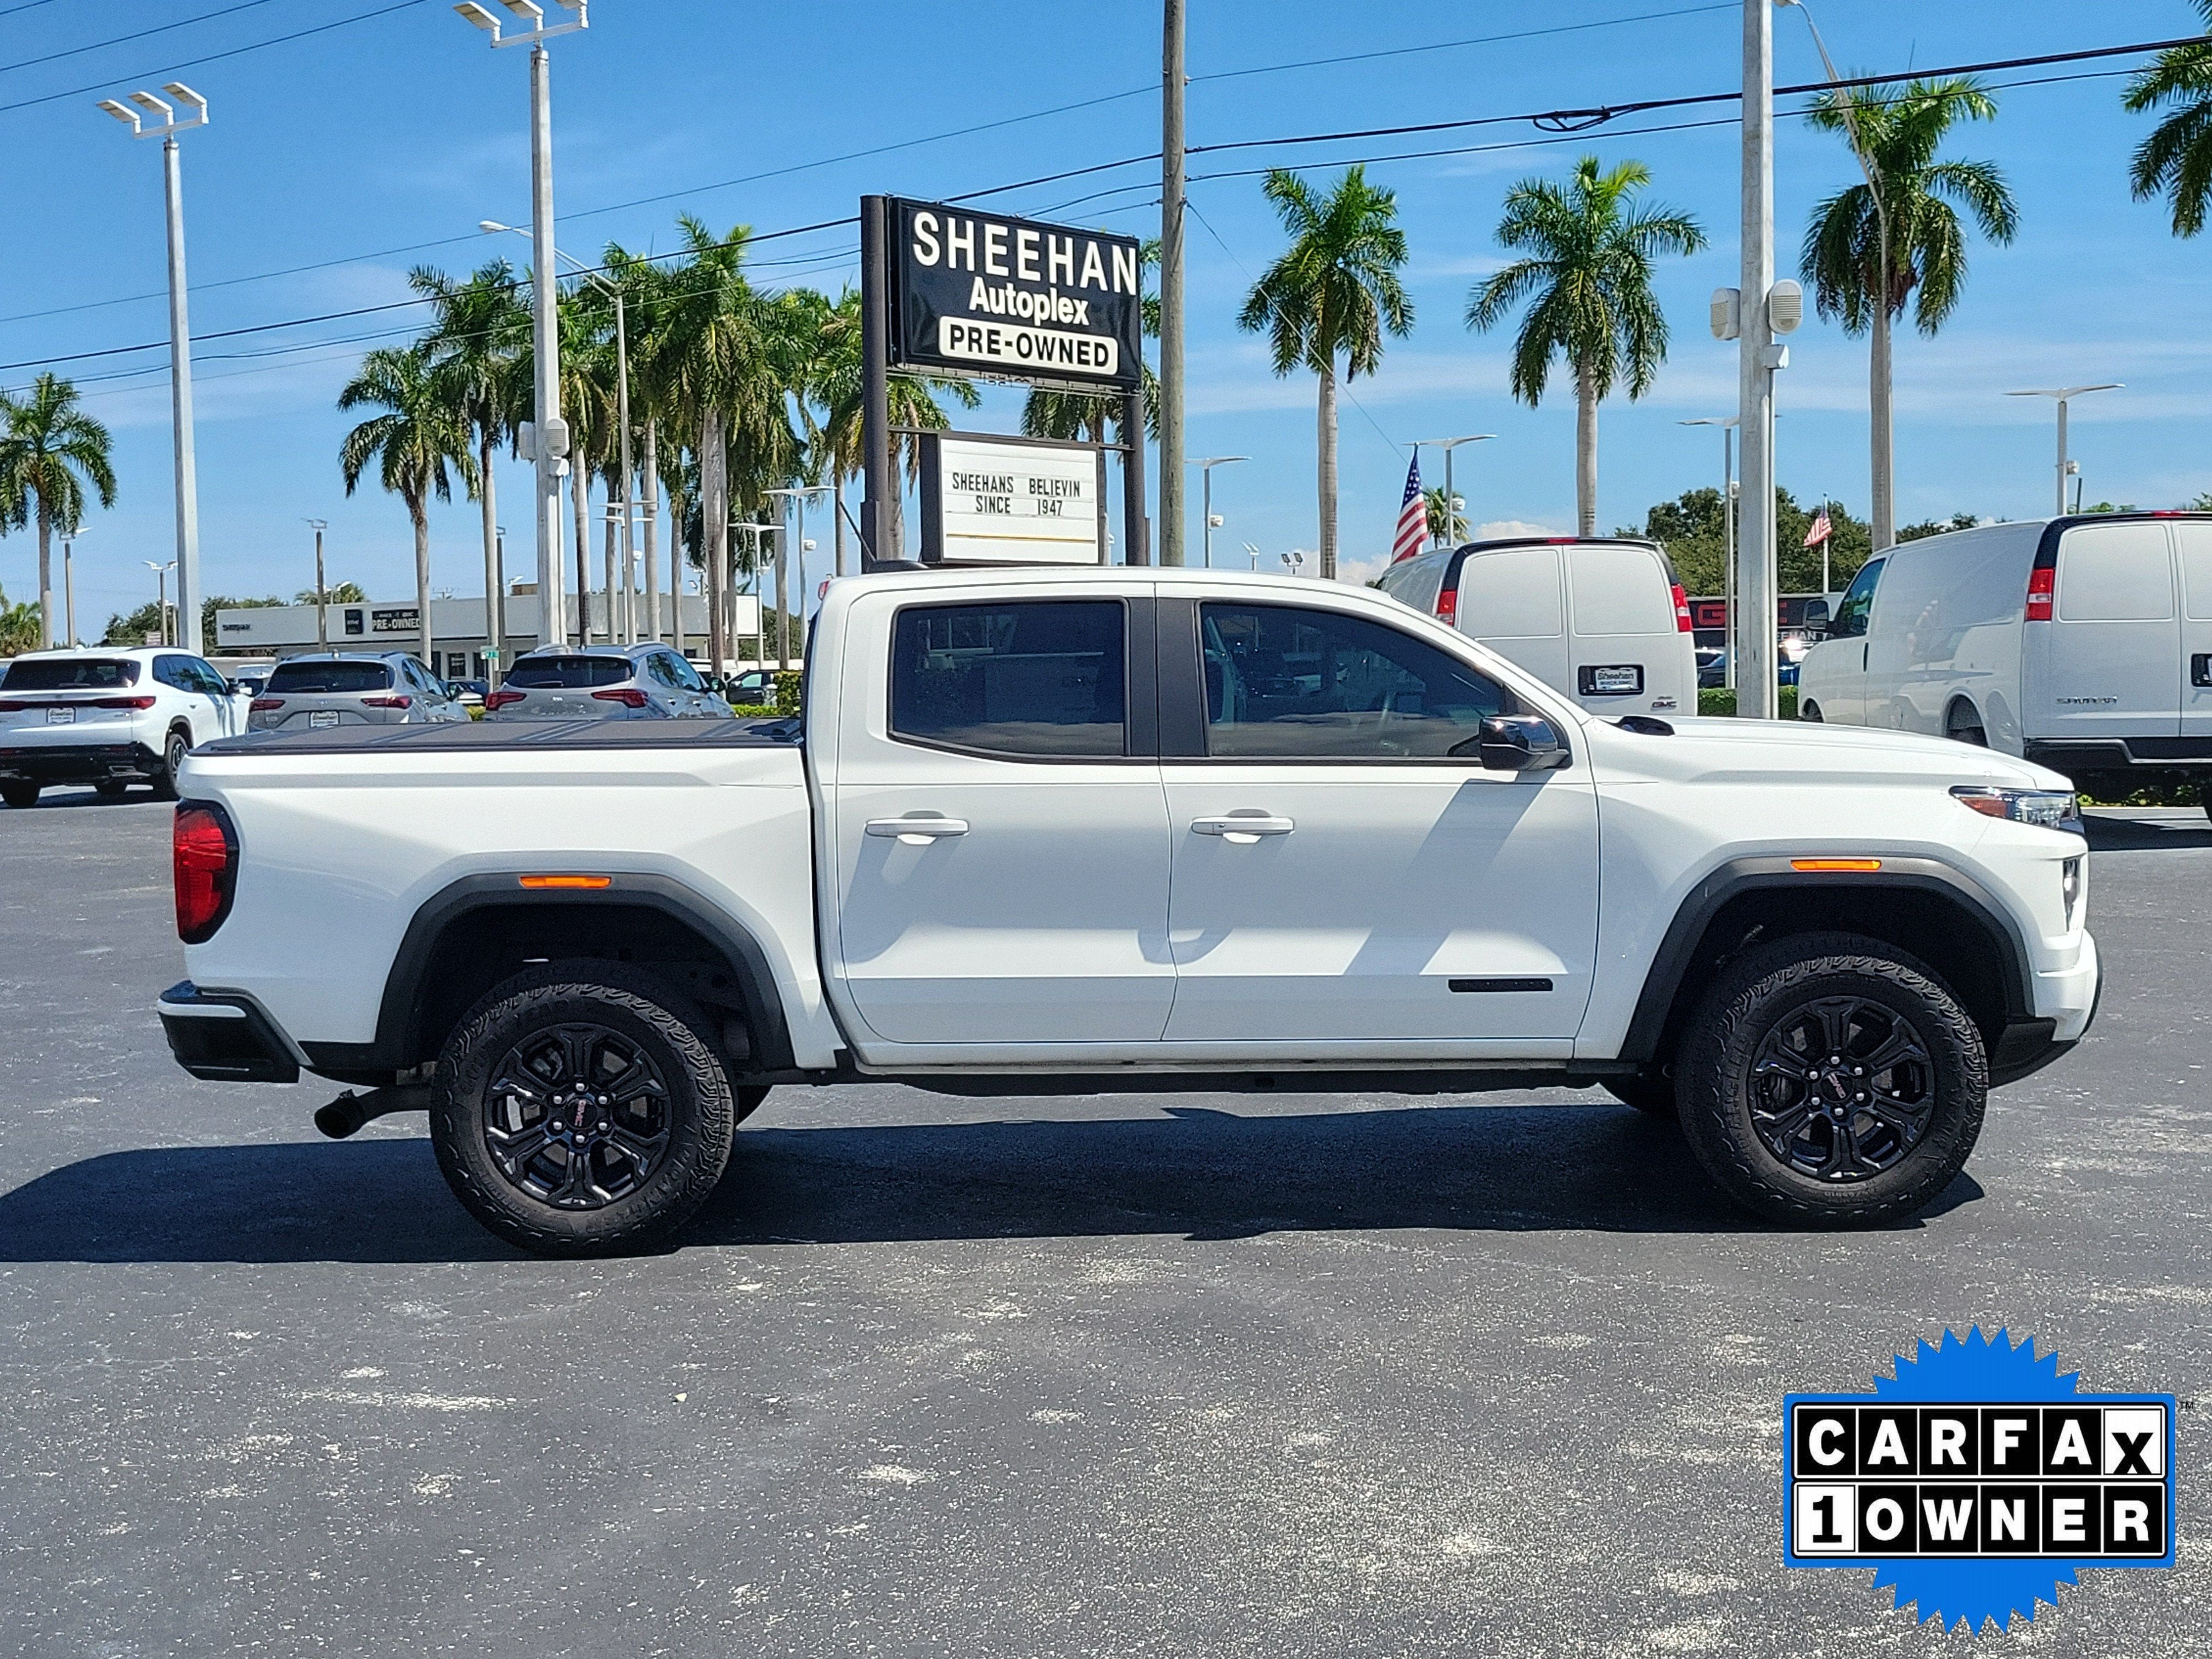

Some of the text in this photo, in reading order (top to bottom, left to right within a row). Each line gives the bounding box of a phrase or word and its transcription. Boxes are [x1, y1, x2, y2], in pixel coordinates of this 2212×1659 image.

[913, 212, 1136, 296] SHEEHAN
[969, 276, 1090, 326] Autoplex
[950, 324, 1109, 367] PRE-OWNED
[952, 472, 1080, 497] SHEEHANS BELIEVIN
[975, 495, 1063, 516] SINCE 1947
